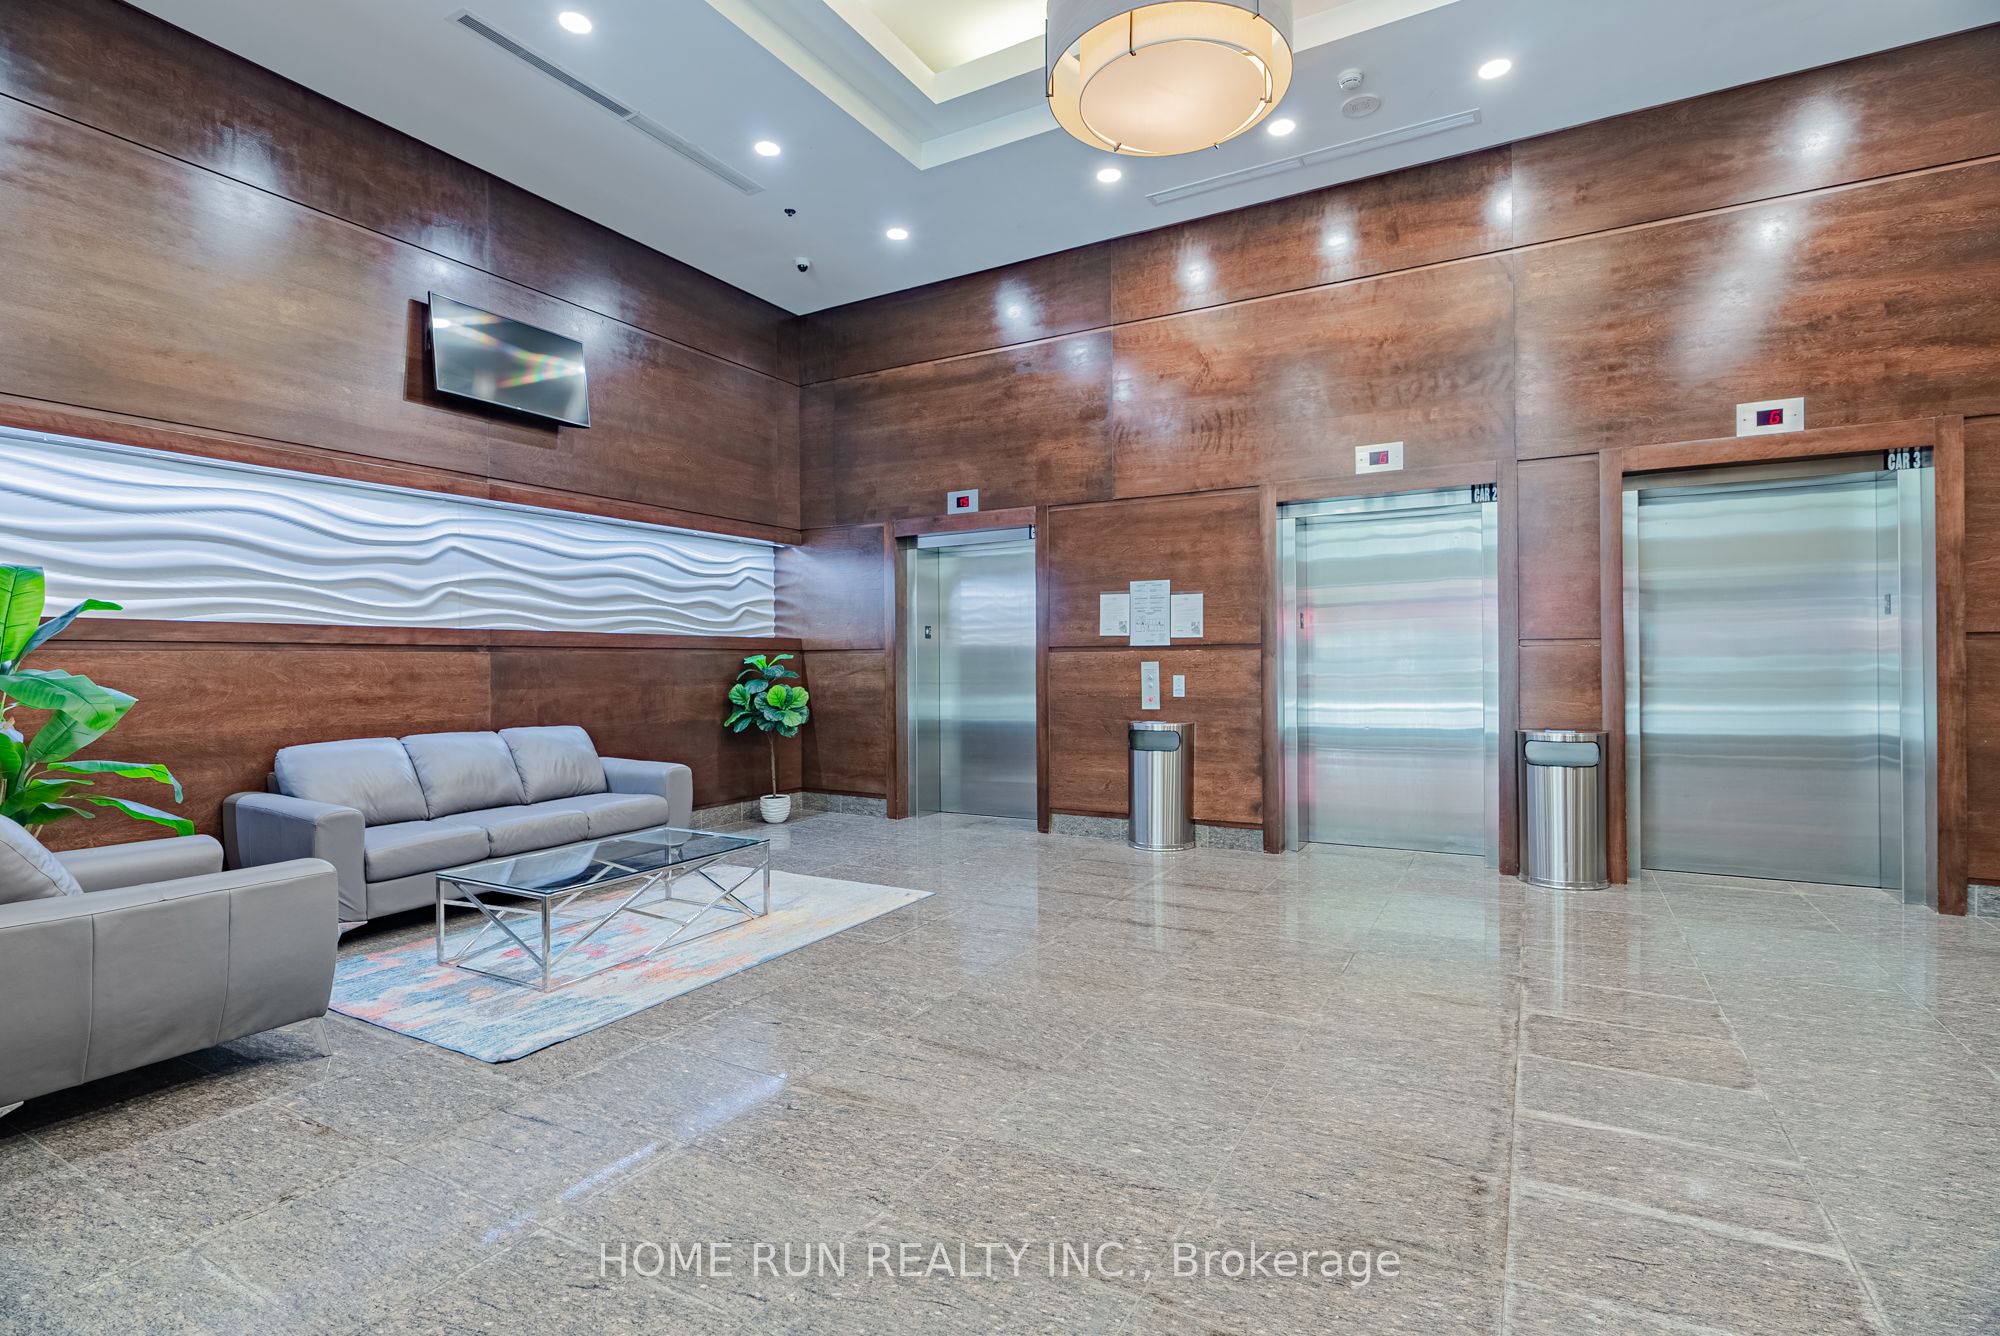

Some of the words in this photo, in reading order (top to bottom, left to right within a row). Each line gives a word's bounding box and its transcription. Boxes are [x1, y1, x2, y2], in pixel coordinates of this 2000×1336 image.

[1888, 452, 1910, 470] CAR
[1913, 452, 1920, 468] 3
[1474, 487, 1490, 502] CAR
[1492, 487, 1497, 501] 2
